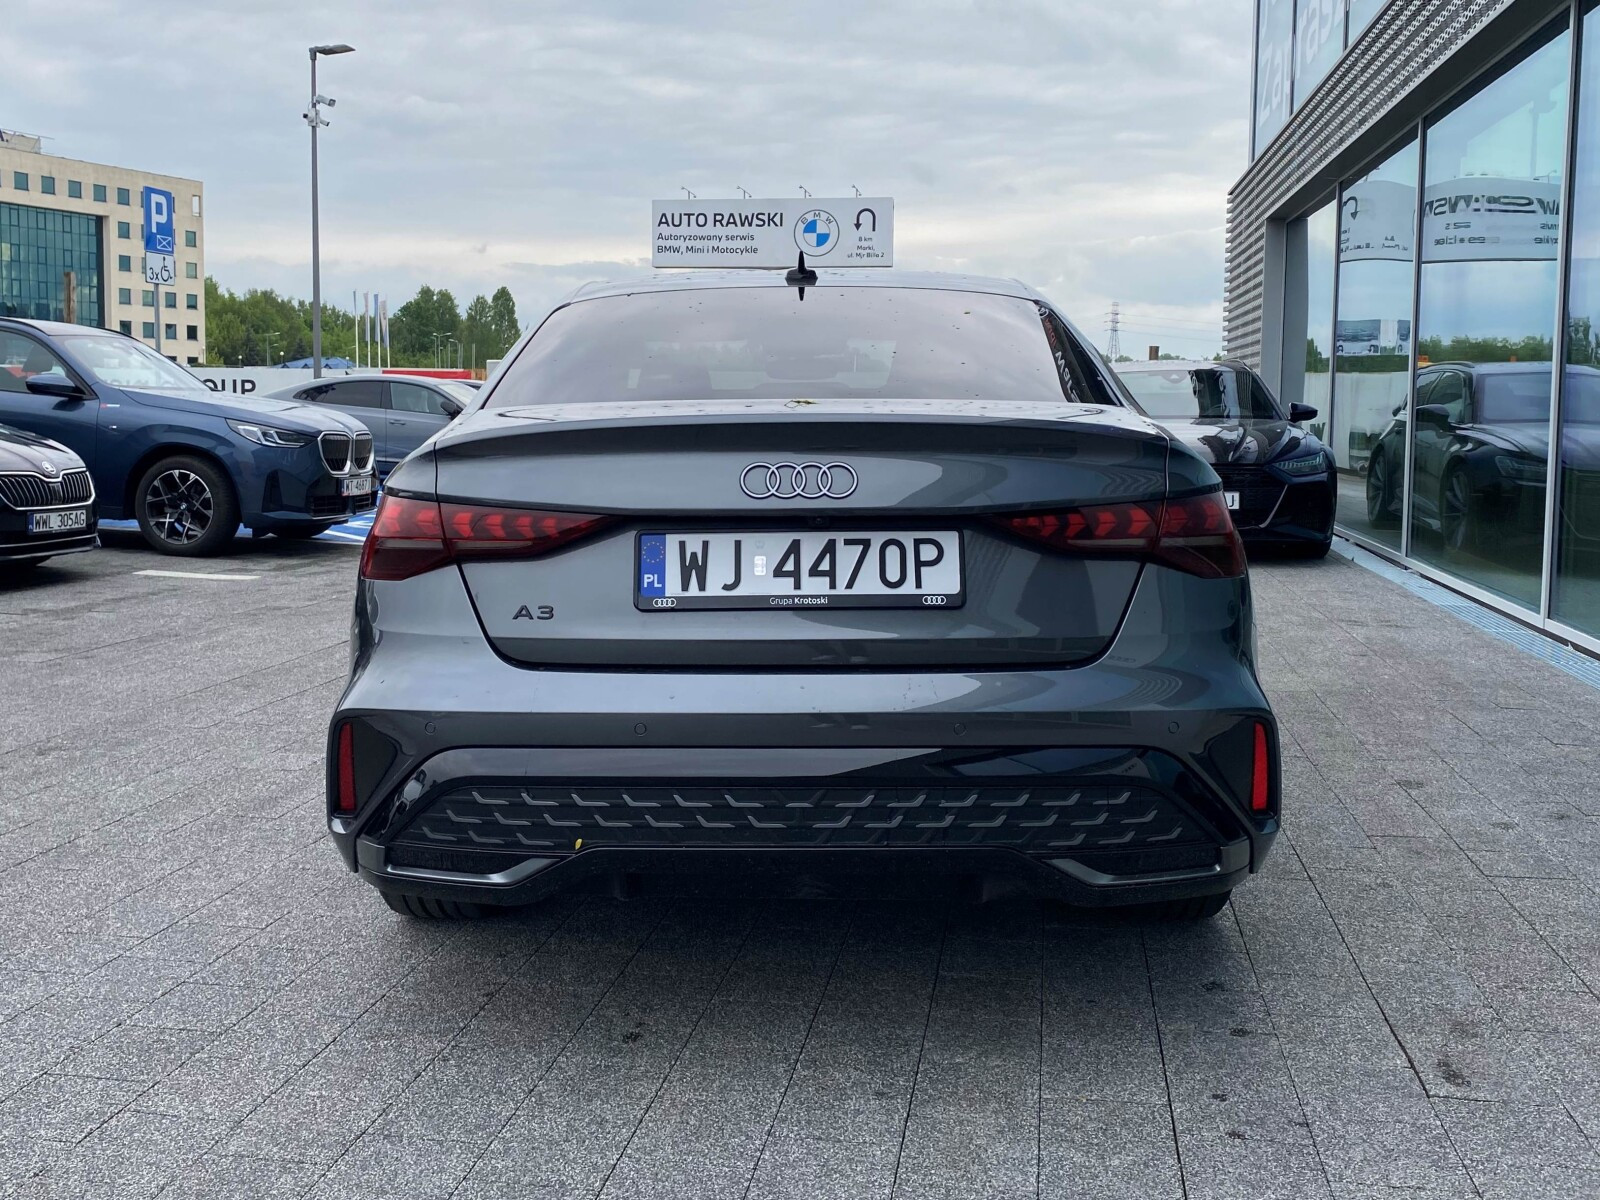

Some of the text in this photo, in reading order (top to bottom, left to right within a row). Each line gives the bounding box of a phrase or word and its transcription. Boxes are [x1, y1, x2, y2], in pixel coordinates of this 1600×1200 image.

[151, 193, 168, 233] P
[657, 212, 783, 228] AUTO RAWSKI
[657, 232, 755, 243] Autoryzowany serwis
[657, 245, 684, 255] BMW,
[686, 245, 705, 254] Mini
[712, 245, 759, 255] Motocykle
[149, 267, 160, 281] 3x
[34, 511, 85, 530] WWL 305AG
[678, 537, 945, 592] WJ 4470P
[643, 574, 662, 588] PL
[769, 595, 829, 605] Grupa Krotoski
[512, 604, 554, 620] A3
